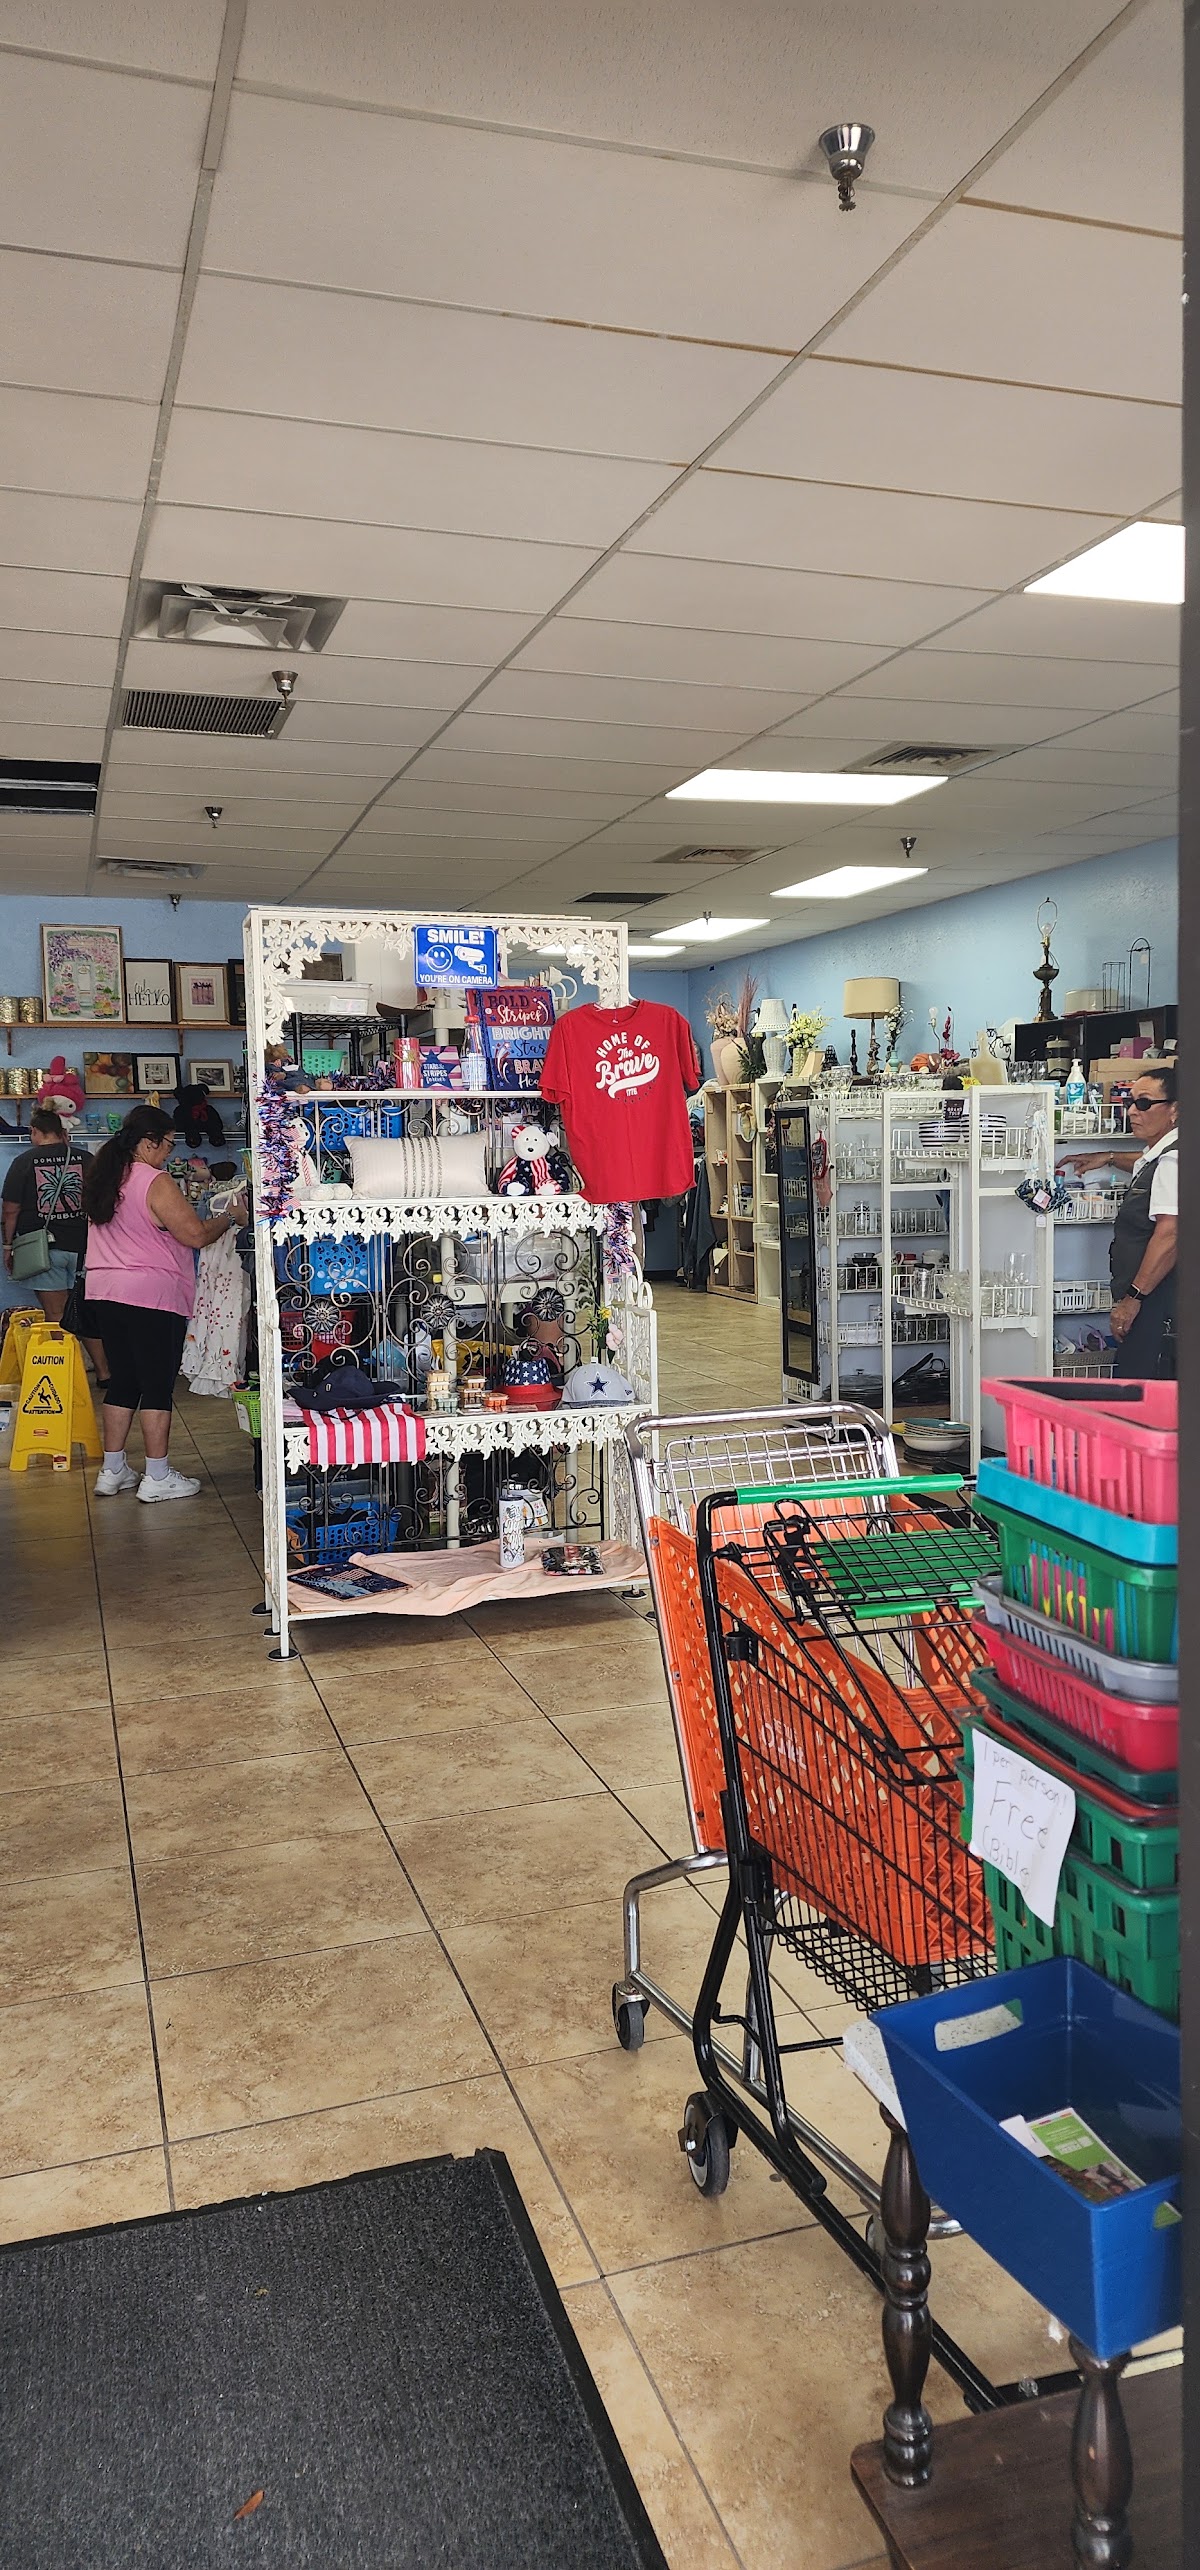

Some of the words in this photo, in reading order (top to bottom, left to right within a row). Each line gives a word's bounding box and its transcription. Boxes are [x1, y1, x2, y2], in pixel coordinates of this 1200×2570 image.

[427, 928, 485, 945] SMILE!
[420, 974, 446, 983] YOU'RE
[449, 975, 460, 984] ON
[461, 976, 493, 985] CAMERA
[128, 993, 170, 1006] HELLO
[488, 995, 528, 1008] BOLD
[497, 1004, 542, 1026] Stripes
[491, 1026, 552, 1041] BRIGHT
[596, 1032, 627, 1058] HOME
[634, 1035, 651, 1050] OF
[617, 1047, 634, 1061] The
[595, 1053, 659, 1093] Brave
[34, 1155, 83, 1164] DOMINIAN
[32, 1356, 64, 1365] CAUTION
[26, 1383, 40, 1404] CAUTION
[48, 1383, 61, 1405] CUIDADO
[992, 1751, 1010, 1767] per
[989, 1780, 1049, 1850] Free
